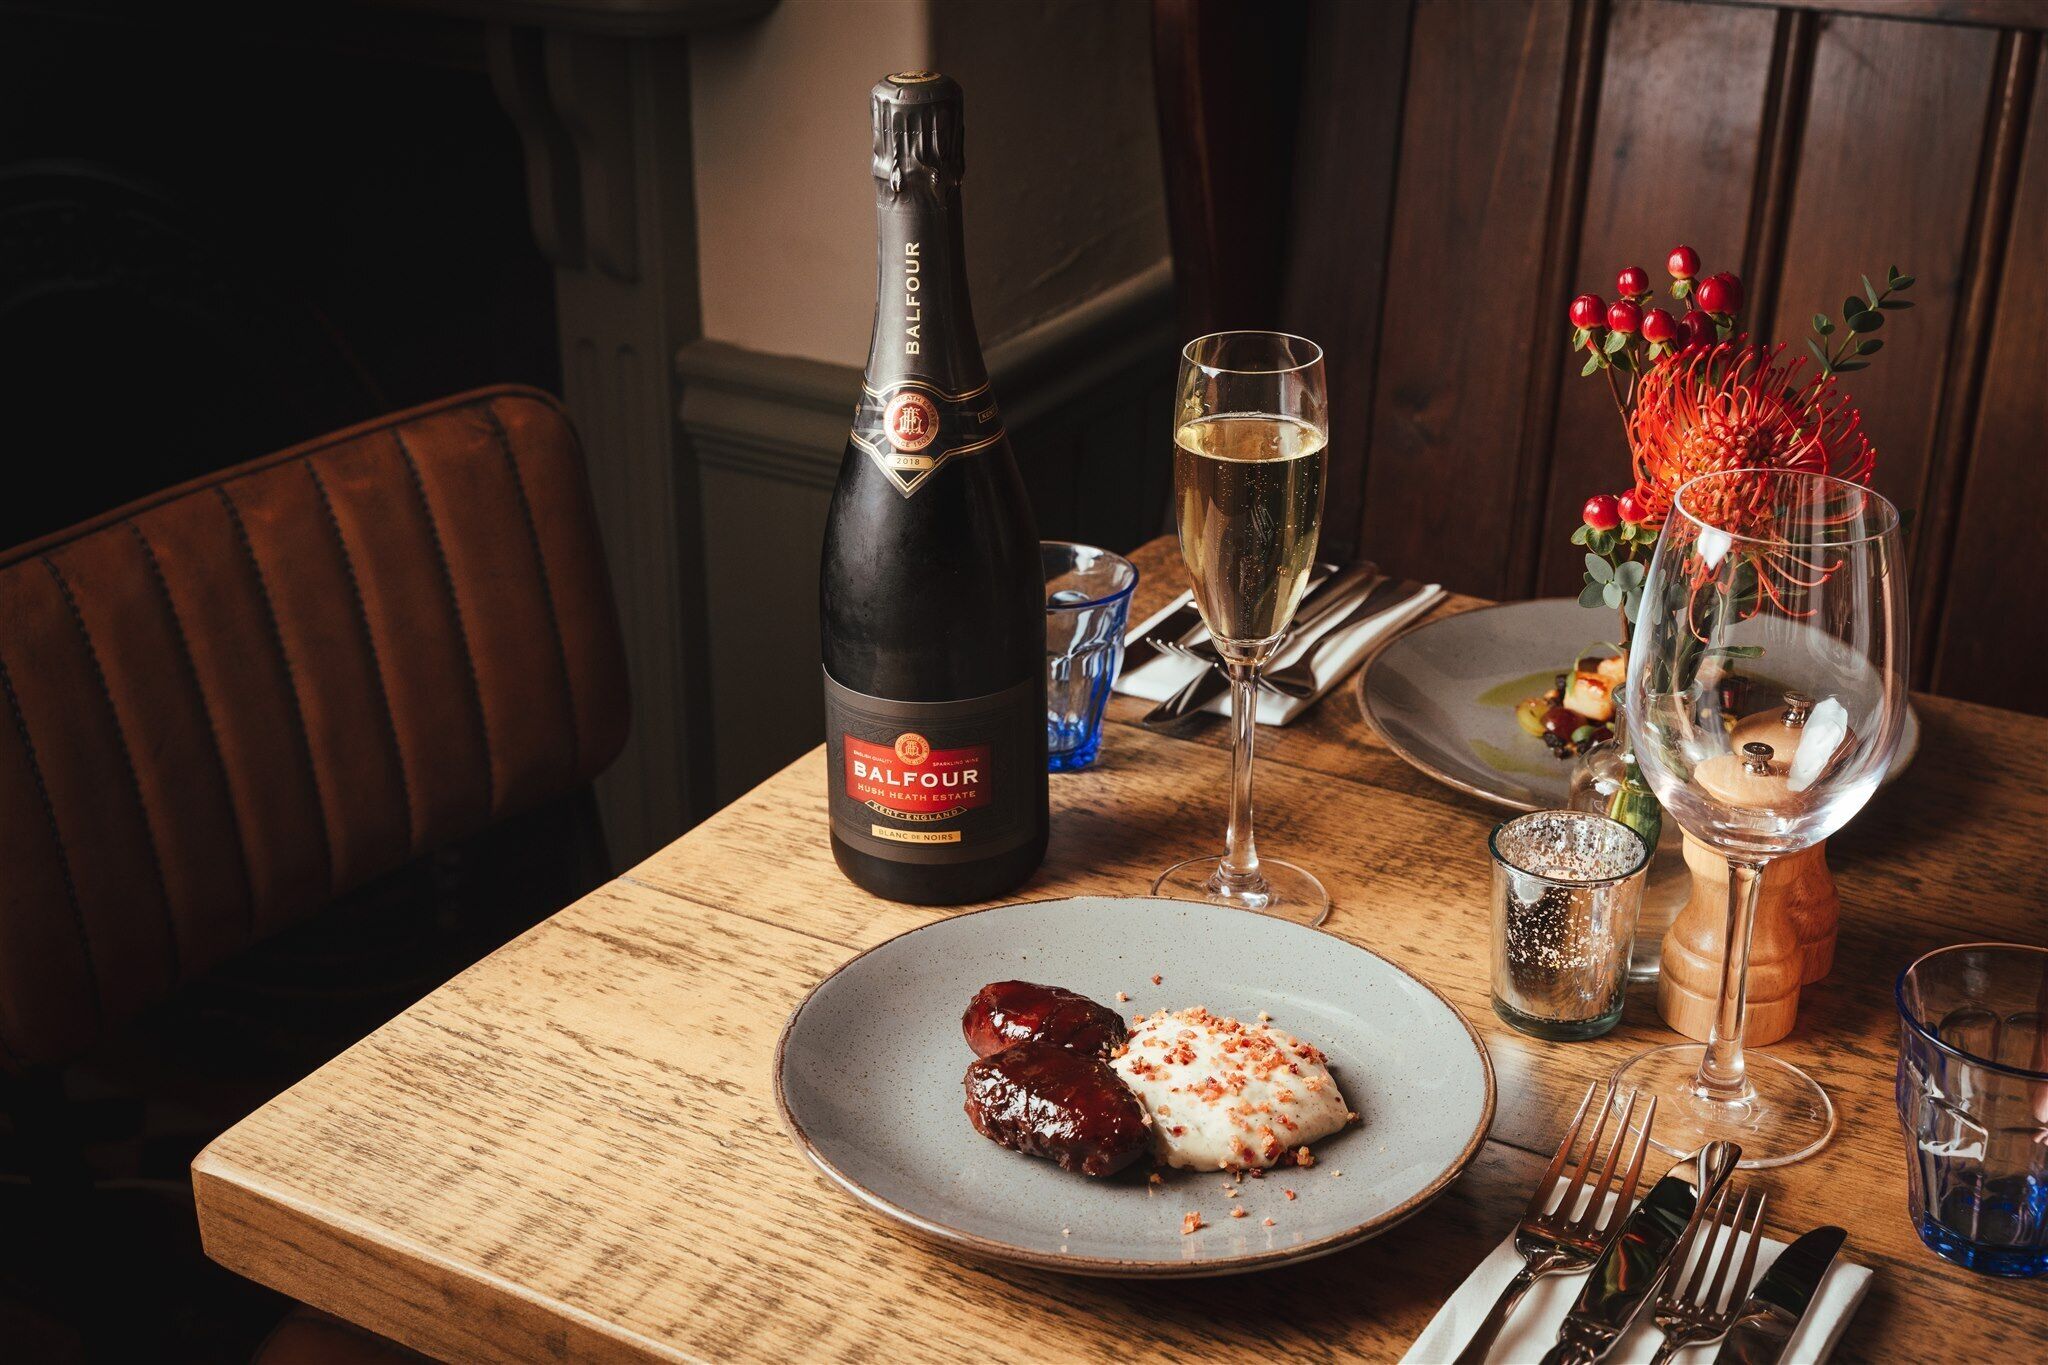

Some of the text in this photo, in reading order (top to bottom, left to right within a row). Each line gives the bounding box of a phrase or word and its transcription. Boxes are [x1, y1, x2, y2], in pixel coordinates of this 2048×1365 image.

[905, 242, 920, 355] BALFOUR
[896, 458, 920, 466] 2018
[932, 759, 964, 767] SPARKLING
[854, 760, 979, 788] BALFOUR
[857, 782, 976, 802] HUSH HEATH ESTATE
[878, 828, 908, 840] BLANC
[923, 833, 953, 841] NOIRS
